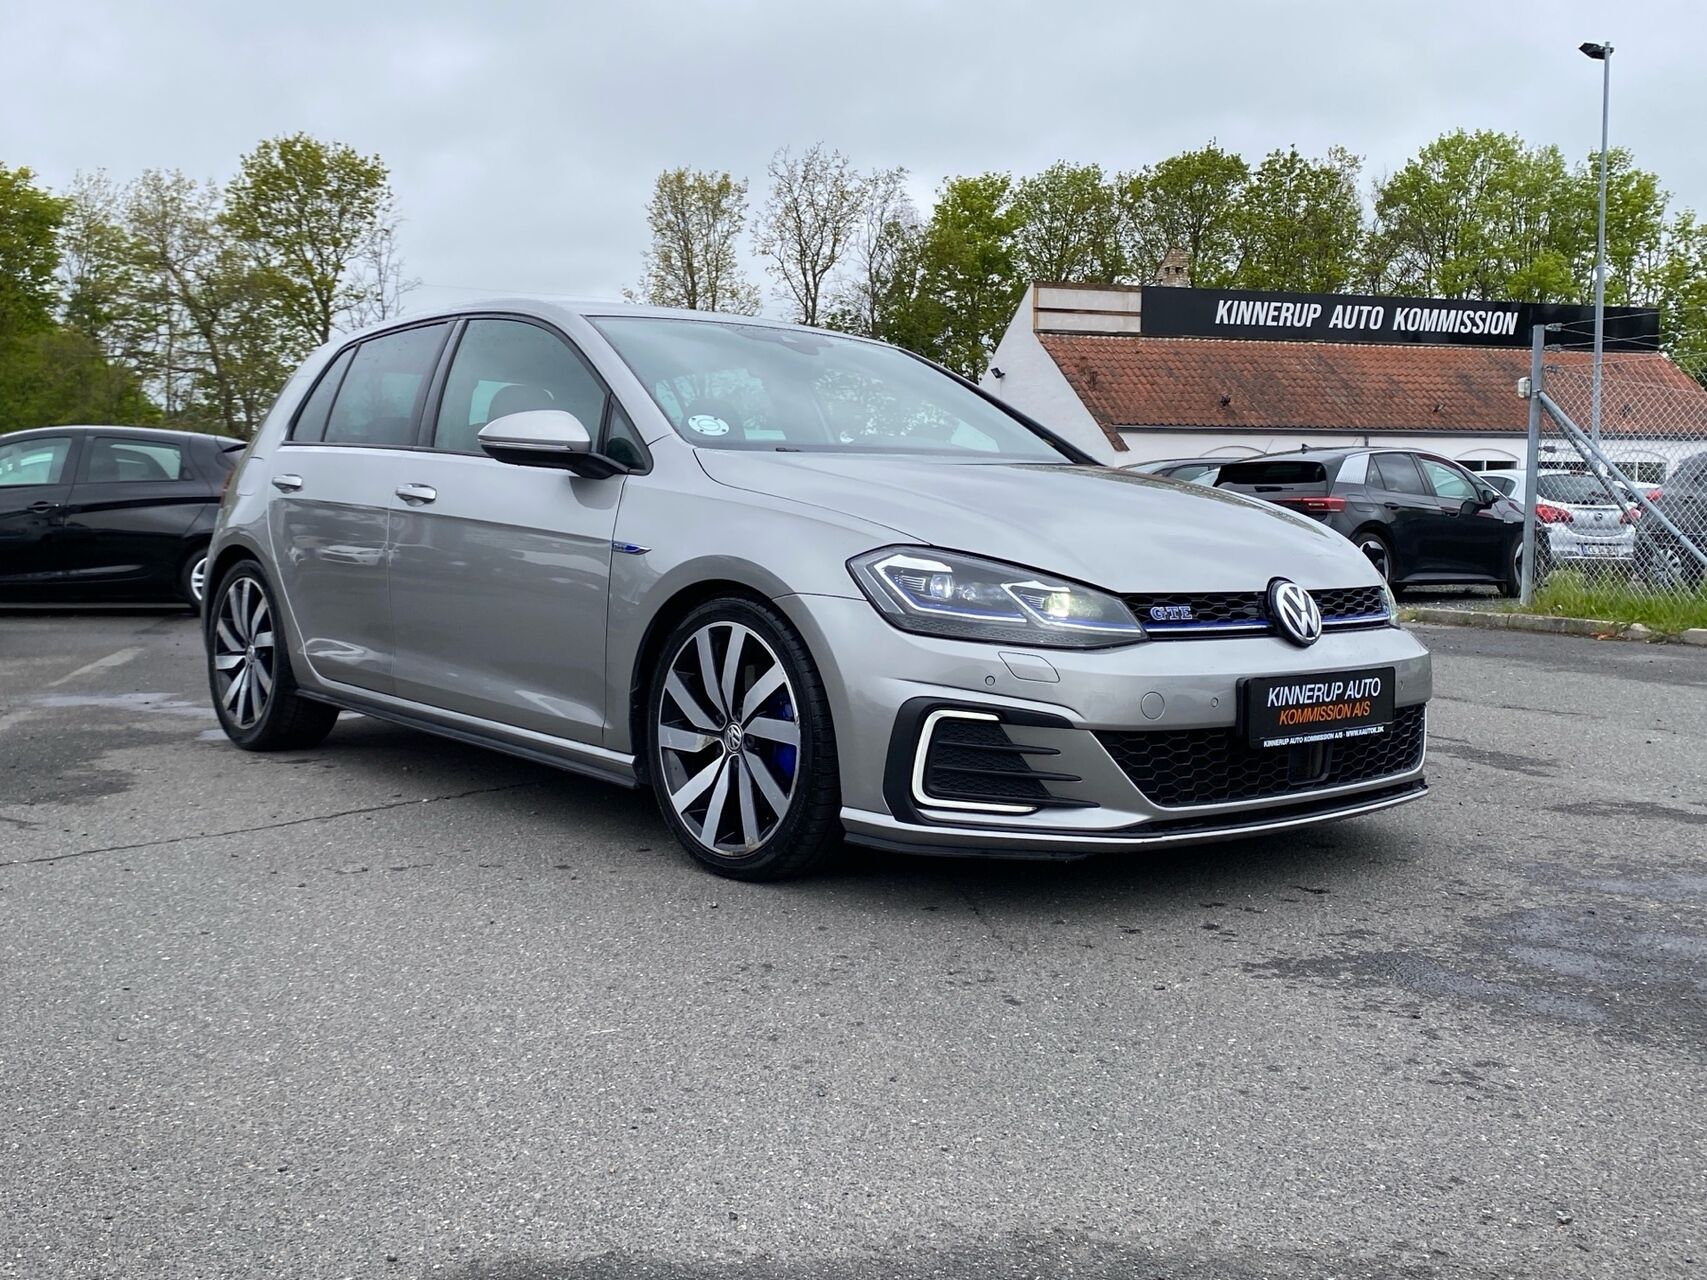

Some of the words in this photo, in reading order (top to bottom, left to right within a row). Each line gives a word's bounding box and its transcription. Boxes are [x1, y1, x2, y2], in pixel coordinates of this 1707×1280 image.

[1215, 300, 1321, 328] KINNERUP
[1328, 304, 1385, 330] AUTO
[1393, 307, 1519, 335] KOMMISSION
[1150, 606, 1192, 620] GTE
[1267, 682, 1343, 707] KINNERUP
[1345, 678, 1381, 699] AUTO
[1279, 703, 1352, 725] KOMMISSION
[1353, 701, 1371, 717] A/S
[1263, 738, 1289, 748] KINNERUP
[1289, 736, 1303, 745] AUTO
[1304, 732, 1334, 742] KOMMISSION
